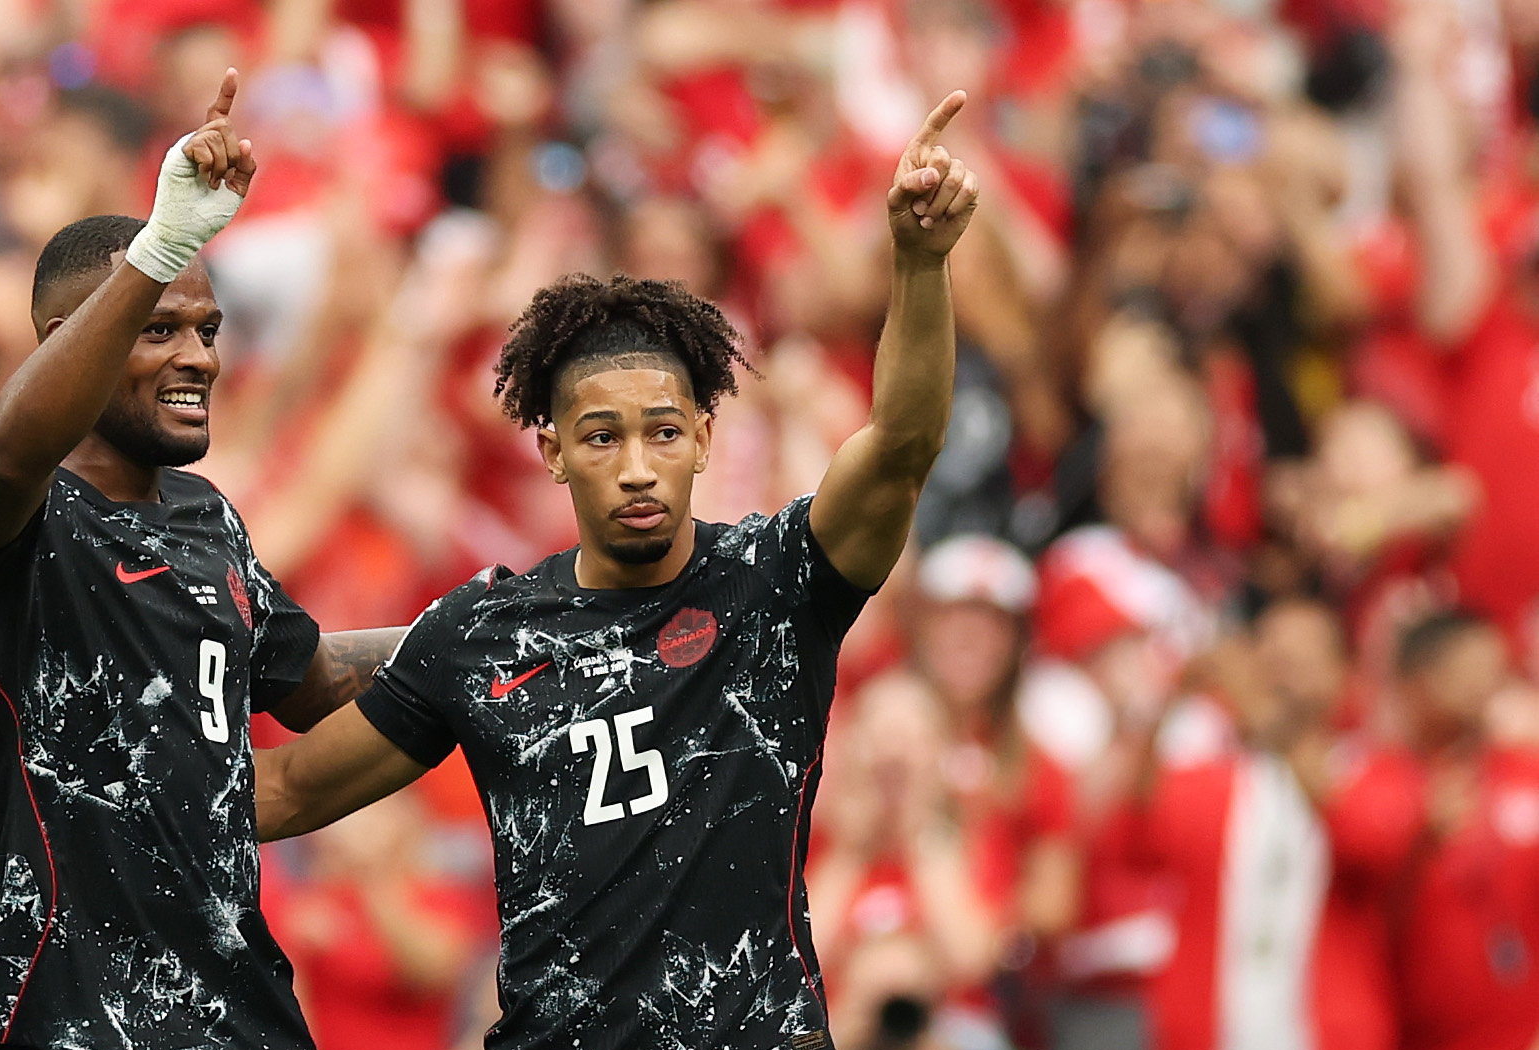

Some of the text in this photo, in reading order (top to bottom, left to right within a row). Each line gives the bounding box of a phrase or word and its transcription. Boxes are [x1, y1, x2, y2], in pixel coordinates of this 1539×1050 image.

[660, 625, 713, 650] CANADA
[198, 639, 229, 744] 9
[568, 705, 669, 826] 25
